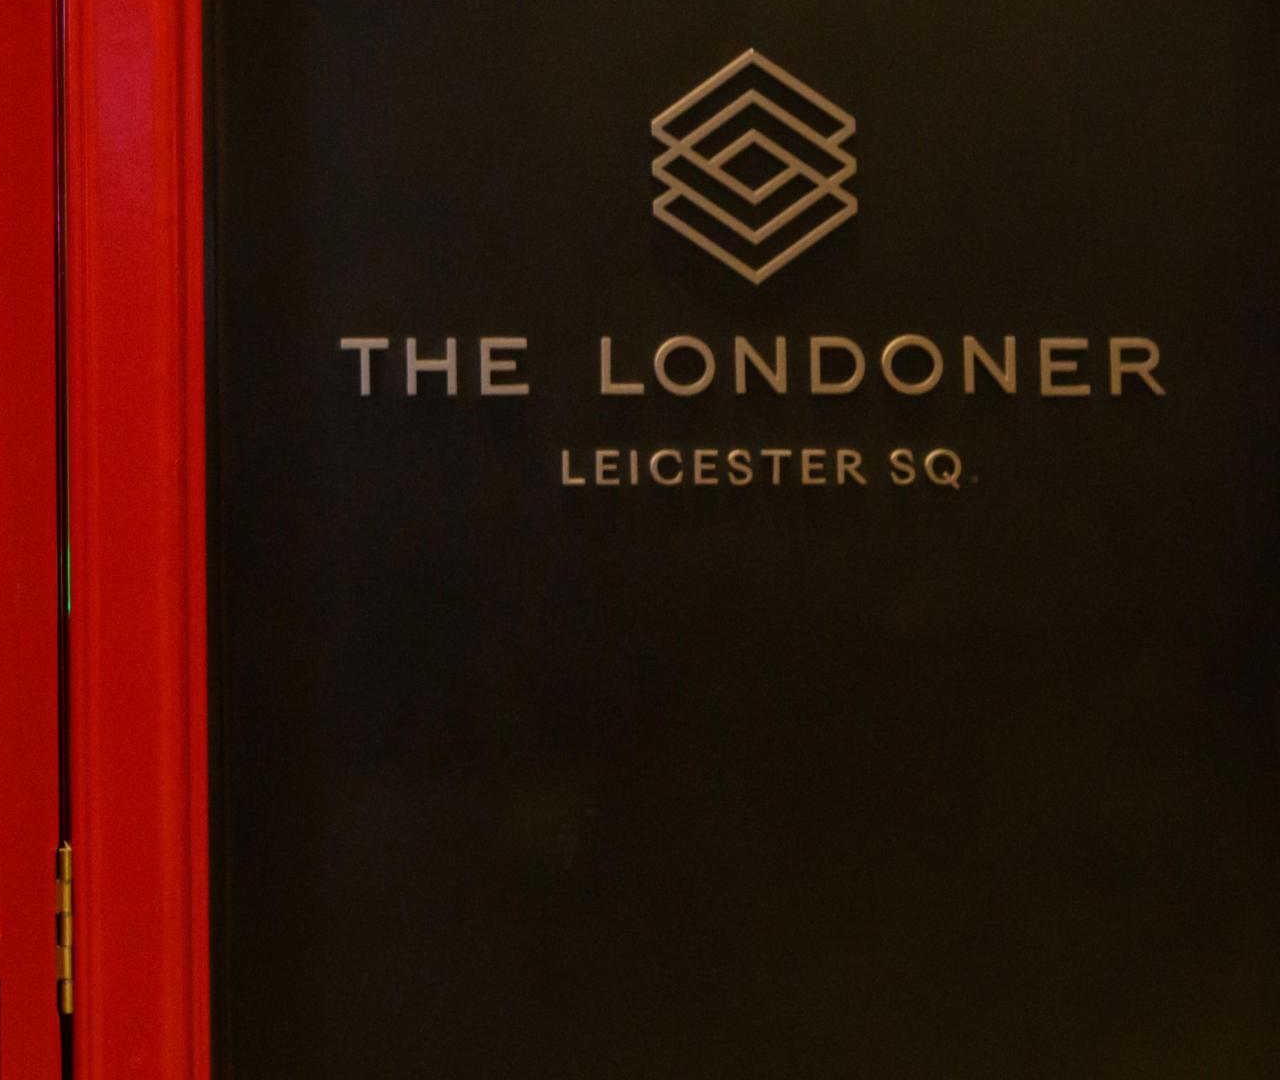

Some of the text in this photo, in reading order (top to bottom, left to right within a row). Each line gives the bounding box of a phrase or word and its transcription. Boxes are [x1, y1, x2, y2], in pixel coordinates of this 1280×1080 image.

[340, 333, 1167, 396] THE LONDONER
[561, 448, 868, 486] LEICESTER
